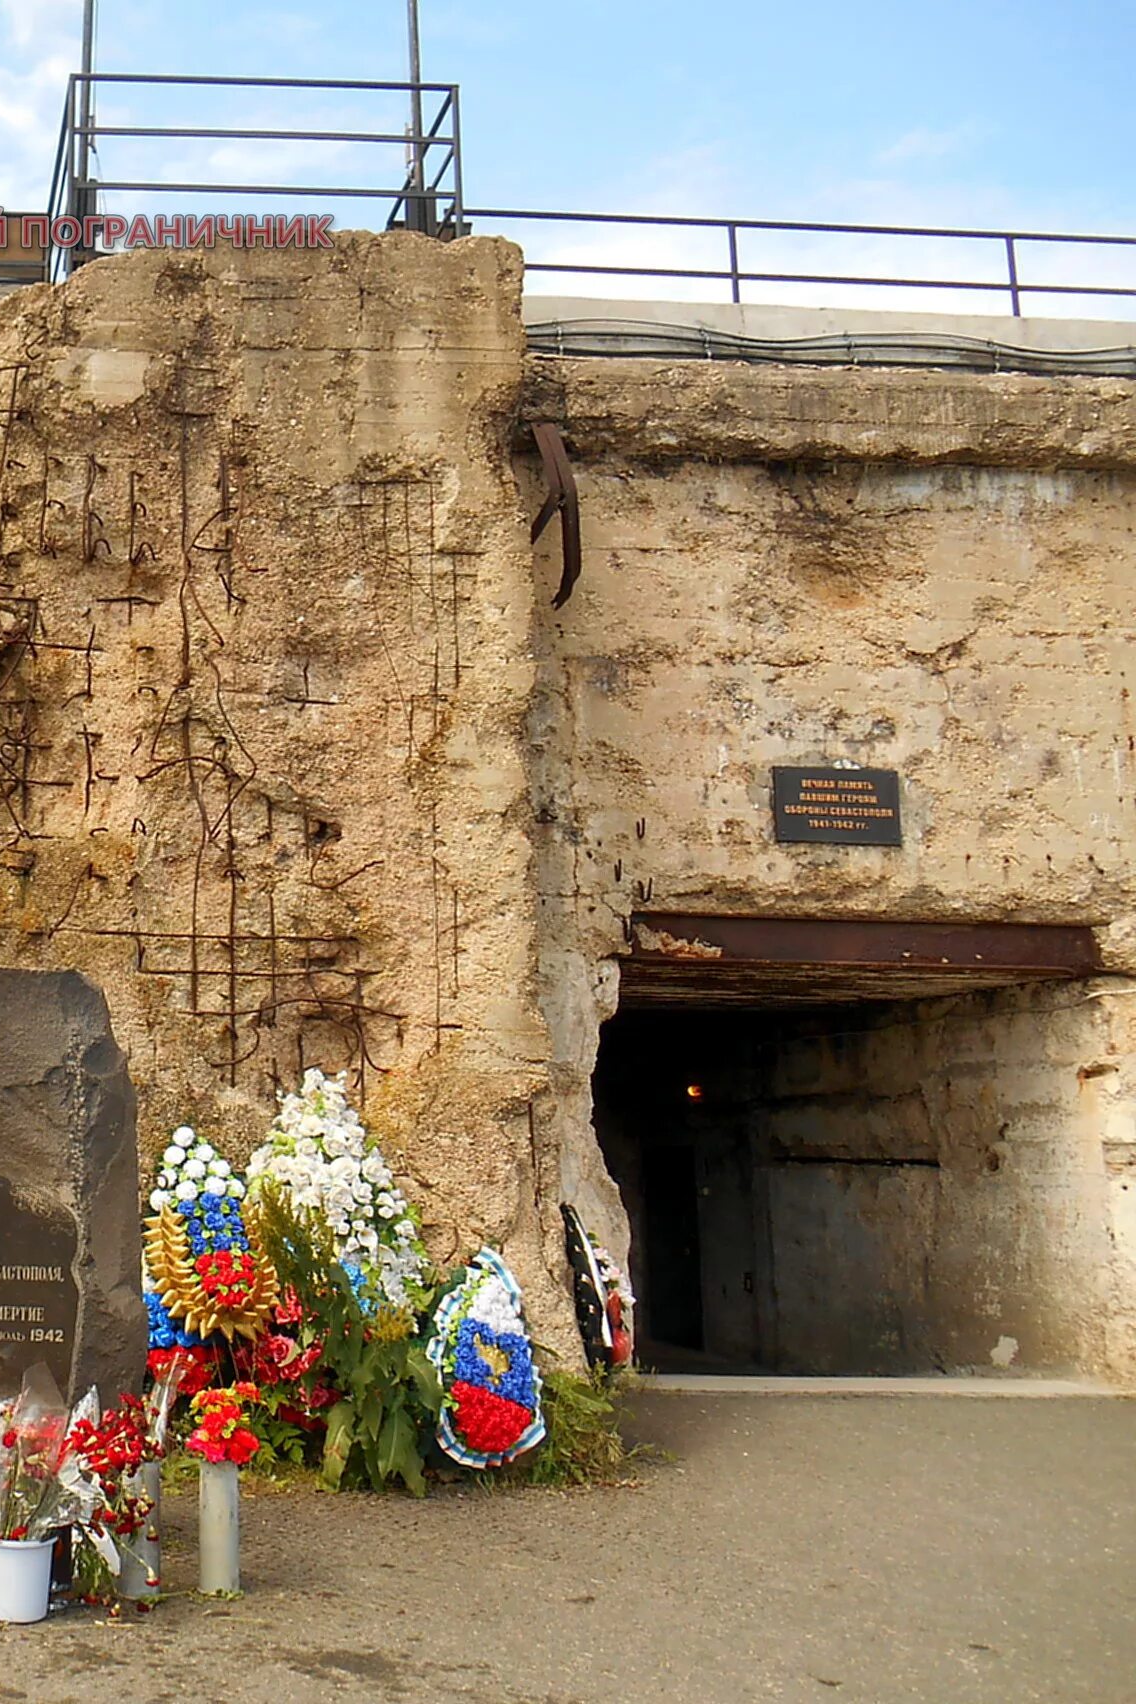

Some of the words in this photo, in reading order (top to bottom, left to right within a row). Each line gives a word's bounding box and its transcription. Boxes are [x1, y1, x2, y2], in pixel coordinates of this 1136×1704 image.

[801, 779, 835, 789] ВЕЧНАЯ
[838, 780, 873, 790] ПАМЯТЬ
[841, 794, 878, 804] ГЕРОЯМ
[784, 805, 828, 815] ОБОРОНЫ
[830, 806, 894, 818] СЕВАСТОПОЛЯ
[809, 819, 854, 829] 1941-1942
[30, 1328, 64, 1343] 1942
